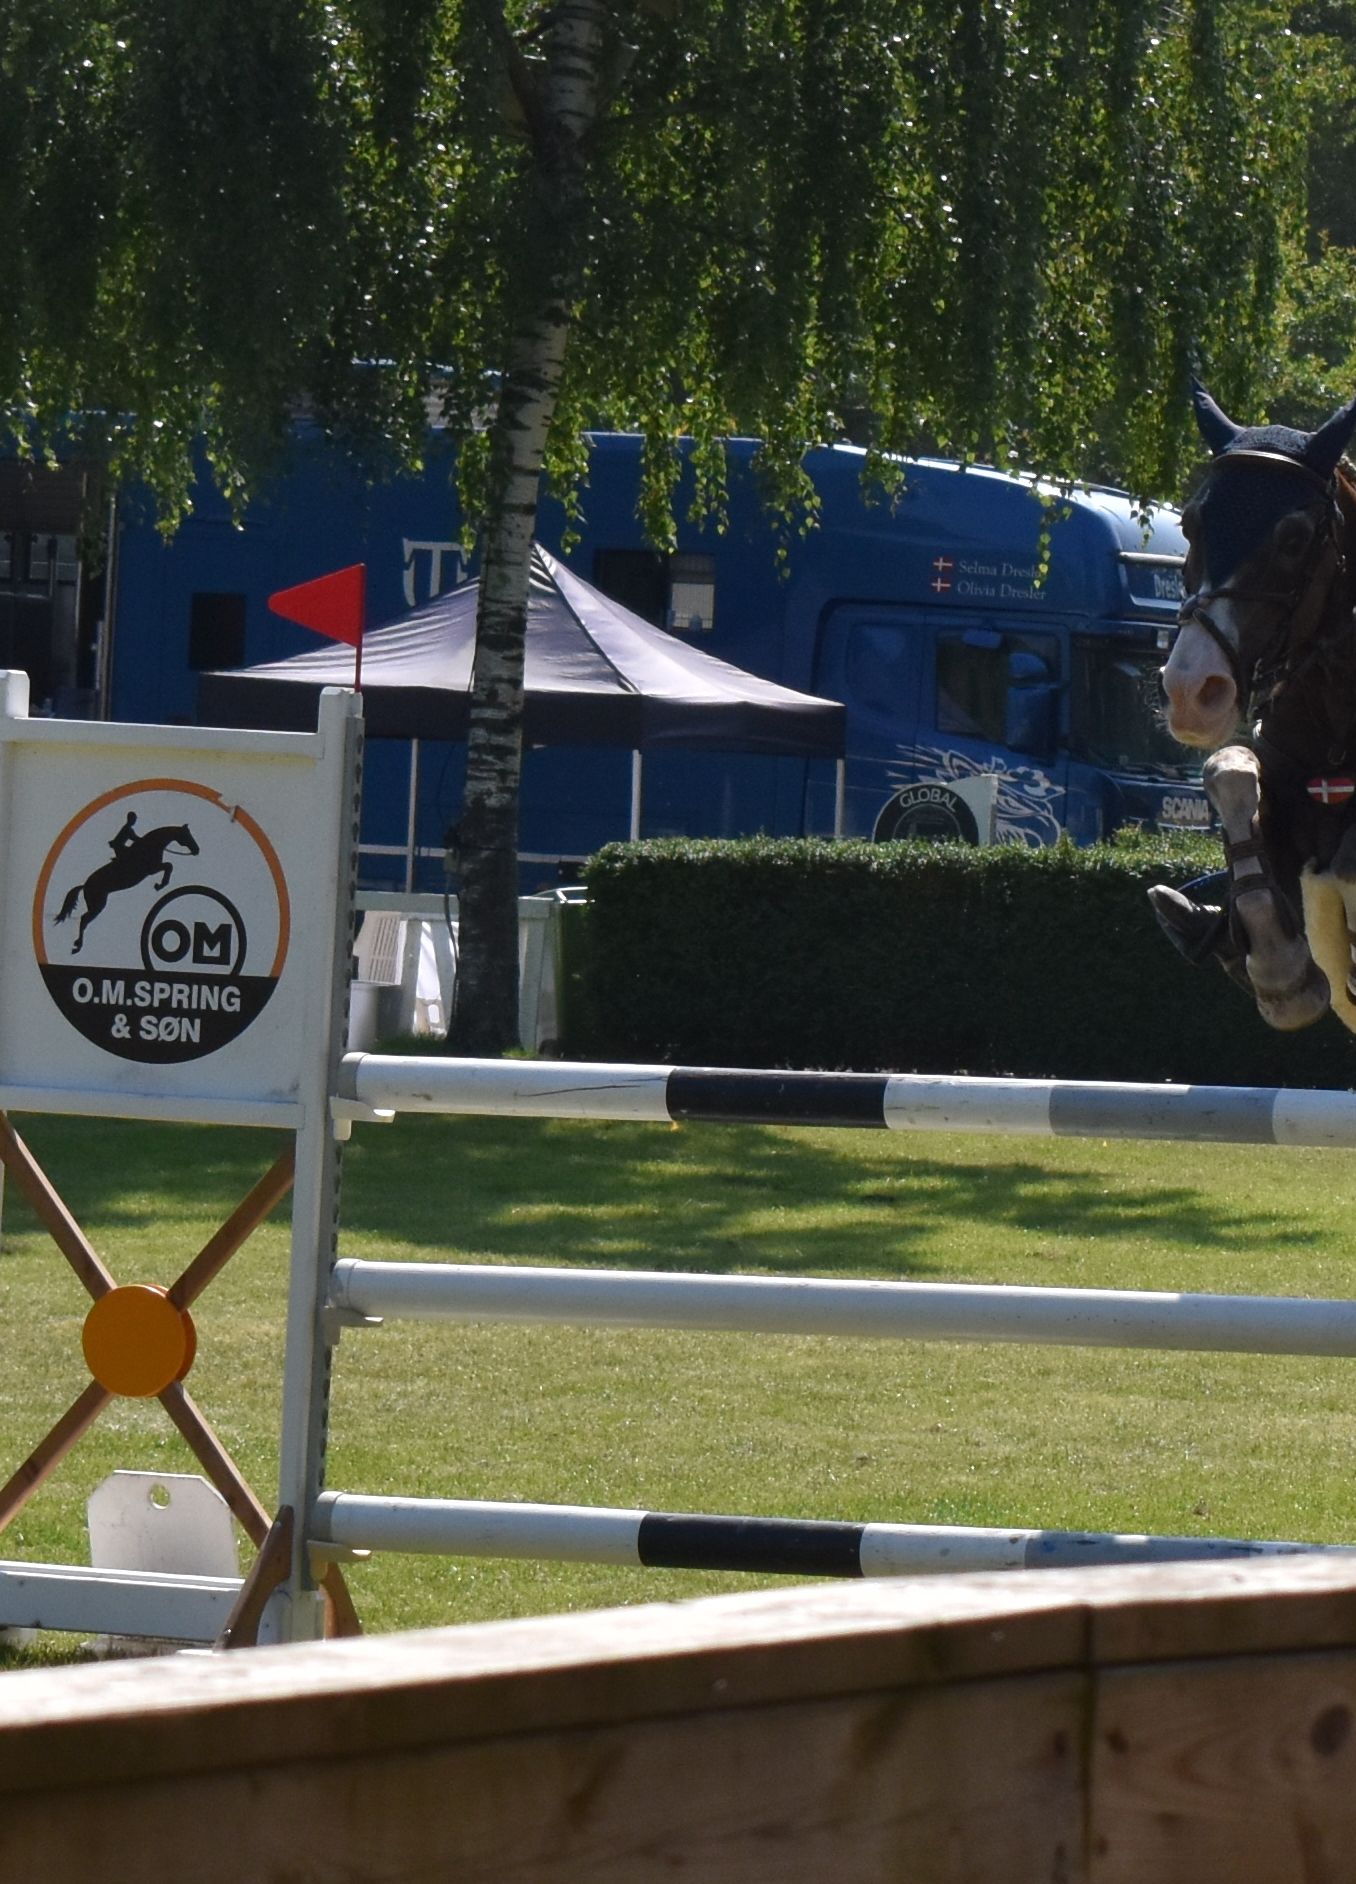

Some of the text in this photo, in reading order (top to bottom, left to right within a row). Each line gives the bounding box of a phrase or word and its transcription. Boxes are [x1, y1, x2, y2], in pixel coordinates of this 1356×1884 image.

[959, 560, 1042, 578] Selma Dresle
[957, 580, 1046, 600] Olivia Dresler
[1153, 573, 1183, 599] Dresl
[900, 787, 958, 813] GLOBAL
[1162, 796, 1209, 821] SCANIA
[151, 919, 232, 966] OM
[72, 977, 241, 1012] O.M.SPRING
[111, 1014, 200, 1043] & SØN
